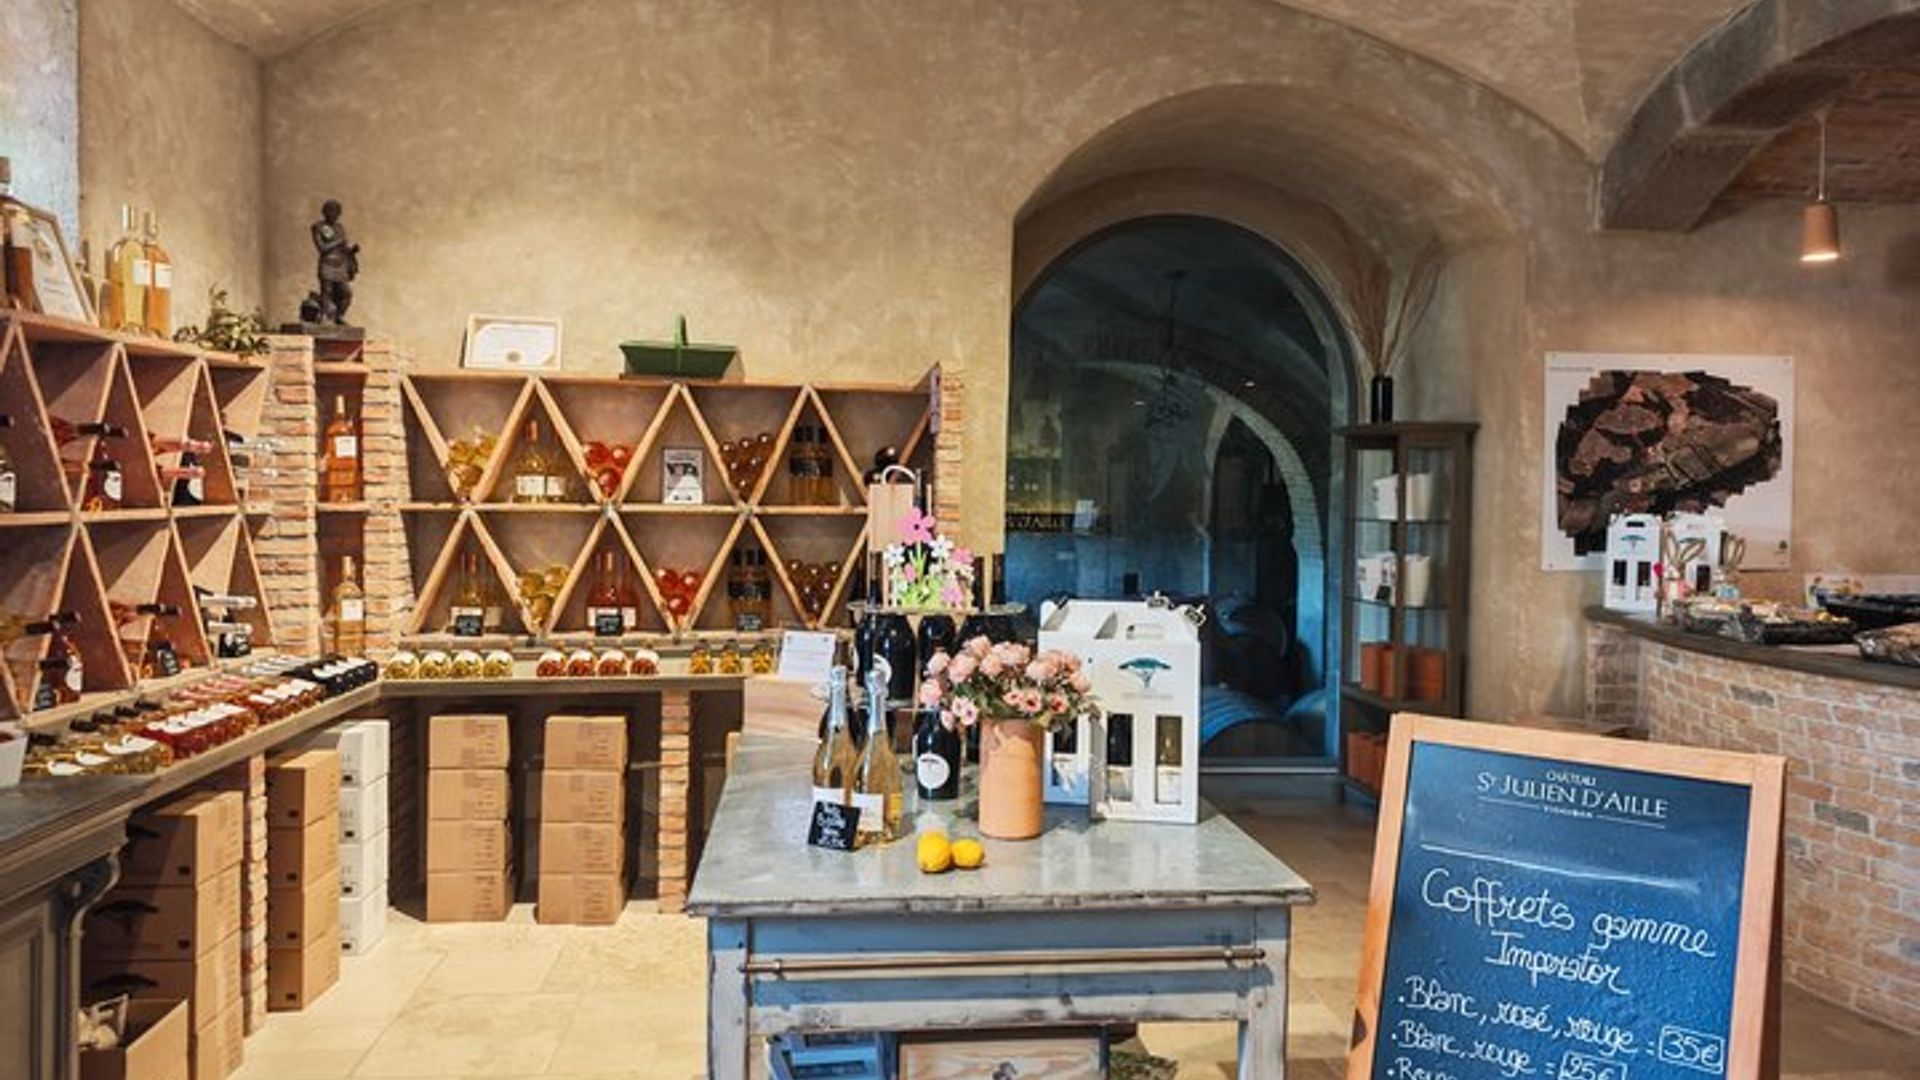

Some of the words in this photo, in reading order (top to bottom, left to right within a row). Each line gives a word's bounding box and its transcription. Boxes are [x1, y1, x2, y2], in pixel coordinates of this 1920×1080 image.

[1500, 774, 1576, 803] JULIEN
[1581, 788, 1669, 819] D'AILLE
[1421, 868, 1575, 930] Coffrets
[1592, 913, 1716, 957] gamme
